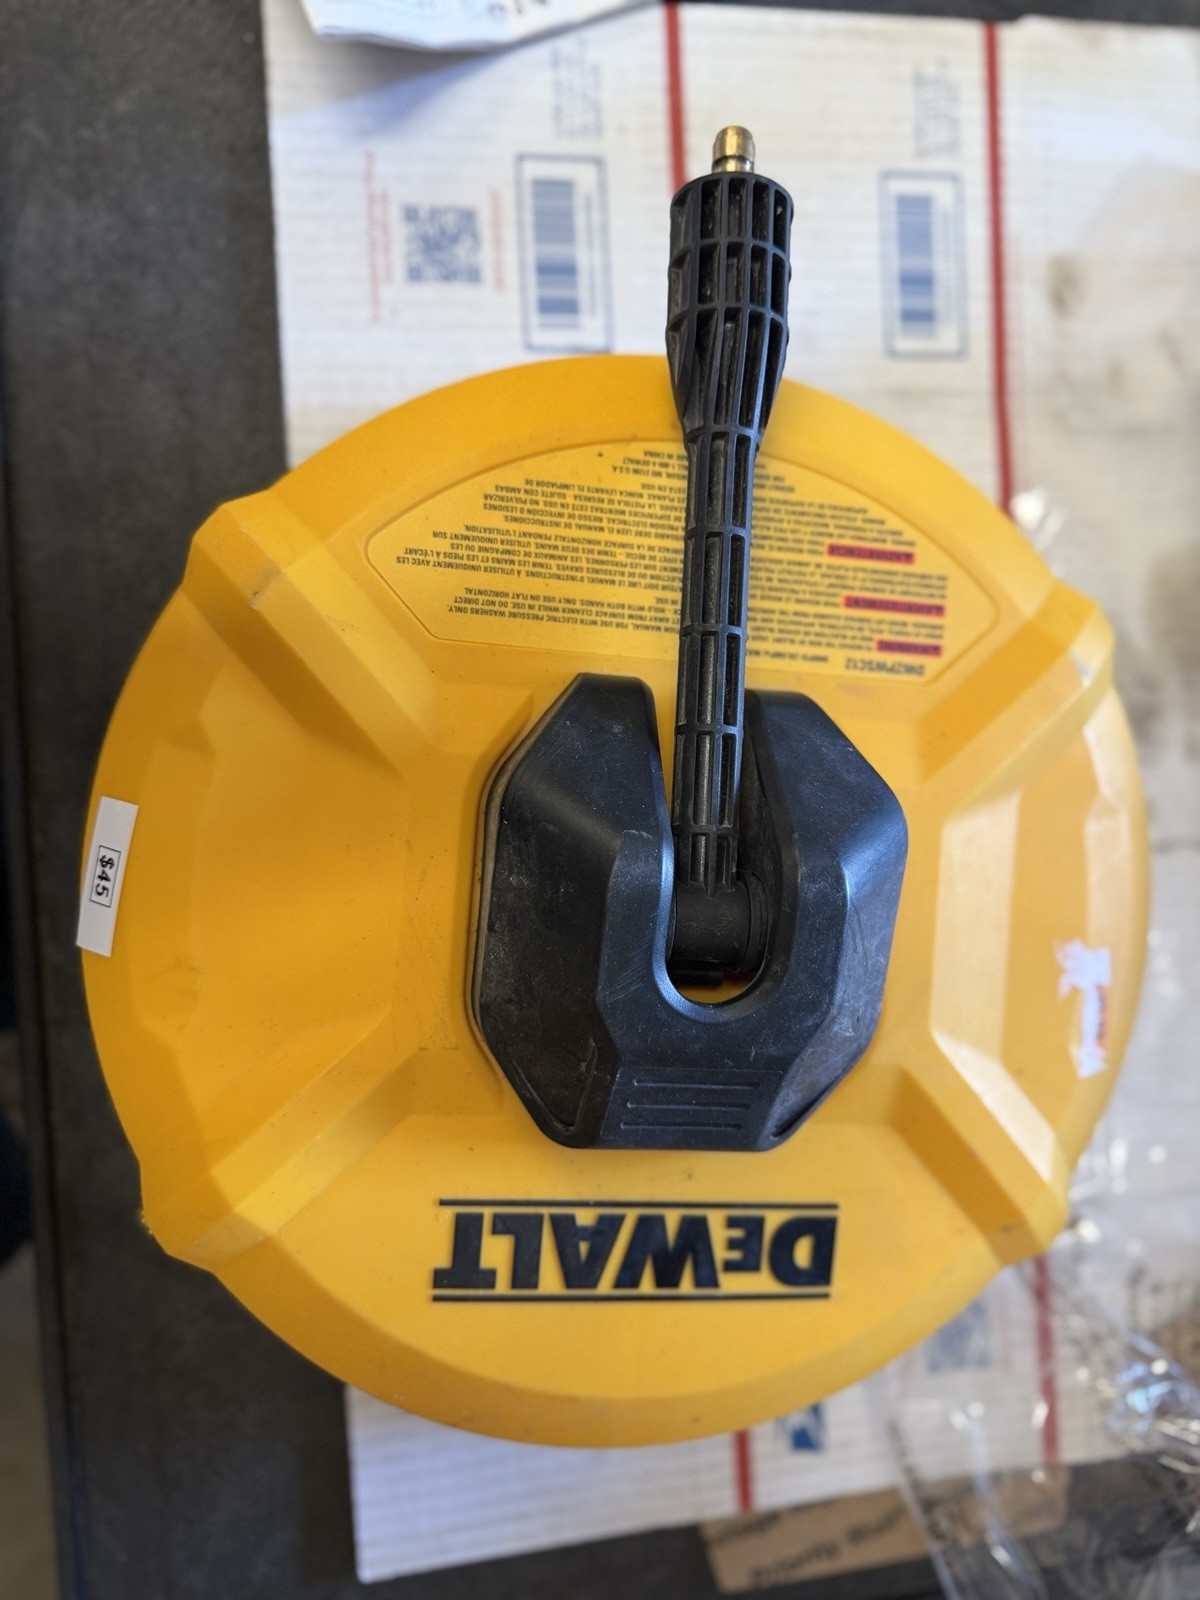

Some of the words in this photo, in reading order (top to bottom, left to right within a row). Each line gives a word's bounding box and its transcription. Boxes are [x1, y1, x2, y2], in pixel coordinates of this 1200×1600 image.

[430, 530, 447, 539] SUR
[449, 532, 498, 544] UNIQUEMENT
[448, 542, 463, 550] LES
[464, 543, 475, 551] OU
[499, 538, 531, 548] UTILISER
[402, 547, 434, 557] L'ÉCART
[477, 545, 521, 556] COMPAGNIE
[560, 545, 579, 553] DEUX
[581, 547, 595, 555] DES
[596, 549, 616, 557] TENIR
[394, 556, 409, 564] LES
[442, 551, 464, 560] PIEDS
[465, 554, 479, 562] LES
[480, 555, 489, 563] ET
[533, 551, 568, 561] ANIMAUX
[569, 555, 582, 563] LES
[625, 552, 646, 561] RECUL
[648, 554, 657, 562] DE
[658, 555, 677, 564] EFFET
[411, 557, 430, 566] AVEC
[432, 559, 481, 572] UNIQUEMENT
[490, 556, 515, 566] MAINS
[517, 559, 530, 567] LES
[531, 561, 552, 570] TENIR
[483, 565, 515, 575] UTILISER
[629, 562, 641, 570] LES
[643, 563, 657, 571] SUR
[585, 566, 625, 577] BLESSURES
[586, 576, 616, 586] MANUEL
[617, 579, 625, 587] LE
[627, 580, 641, 588] LIRE
[643, 582, 659, 590] DOIT
[462, 586, 509, 598] HORIZONTAL
[511, 592, 528, 600] FLAT
[452, 595, 479, 605] DIRECT
[529, 593, 540, 601] ON
[542, 595, 556, 603] USE
[557, 596, 576, 605] ONLY
[481, 598, 496, 606] NOT
[497, 600, 508, 608] DO
[606, 601, 625, 610] BOTH
[469, 606, 505, 617] WASHERS
[537, 604, 559, 613] WHILE
[561, 606, 593, 616] CLEANER
[627, 603, 645, 612] WITH
[647, 605, 665, 614] HOLD
[507, 610, 544, 621] PRESSURE
[594, 609, 625, 619] SURFACE
[627, 613, 647, 621] FROM
[545, 614, 578, 624] ELECTRIC
[579, 617, 598, 626] WITH
[599, 619, 613, 628] USE
[648, 615, 669, 624] AWAY
[614, 621, 628, 629] FOR
[95, 854, 115, 897] $45
[432, 1211, 837, 1290] DEWALT
